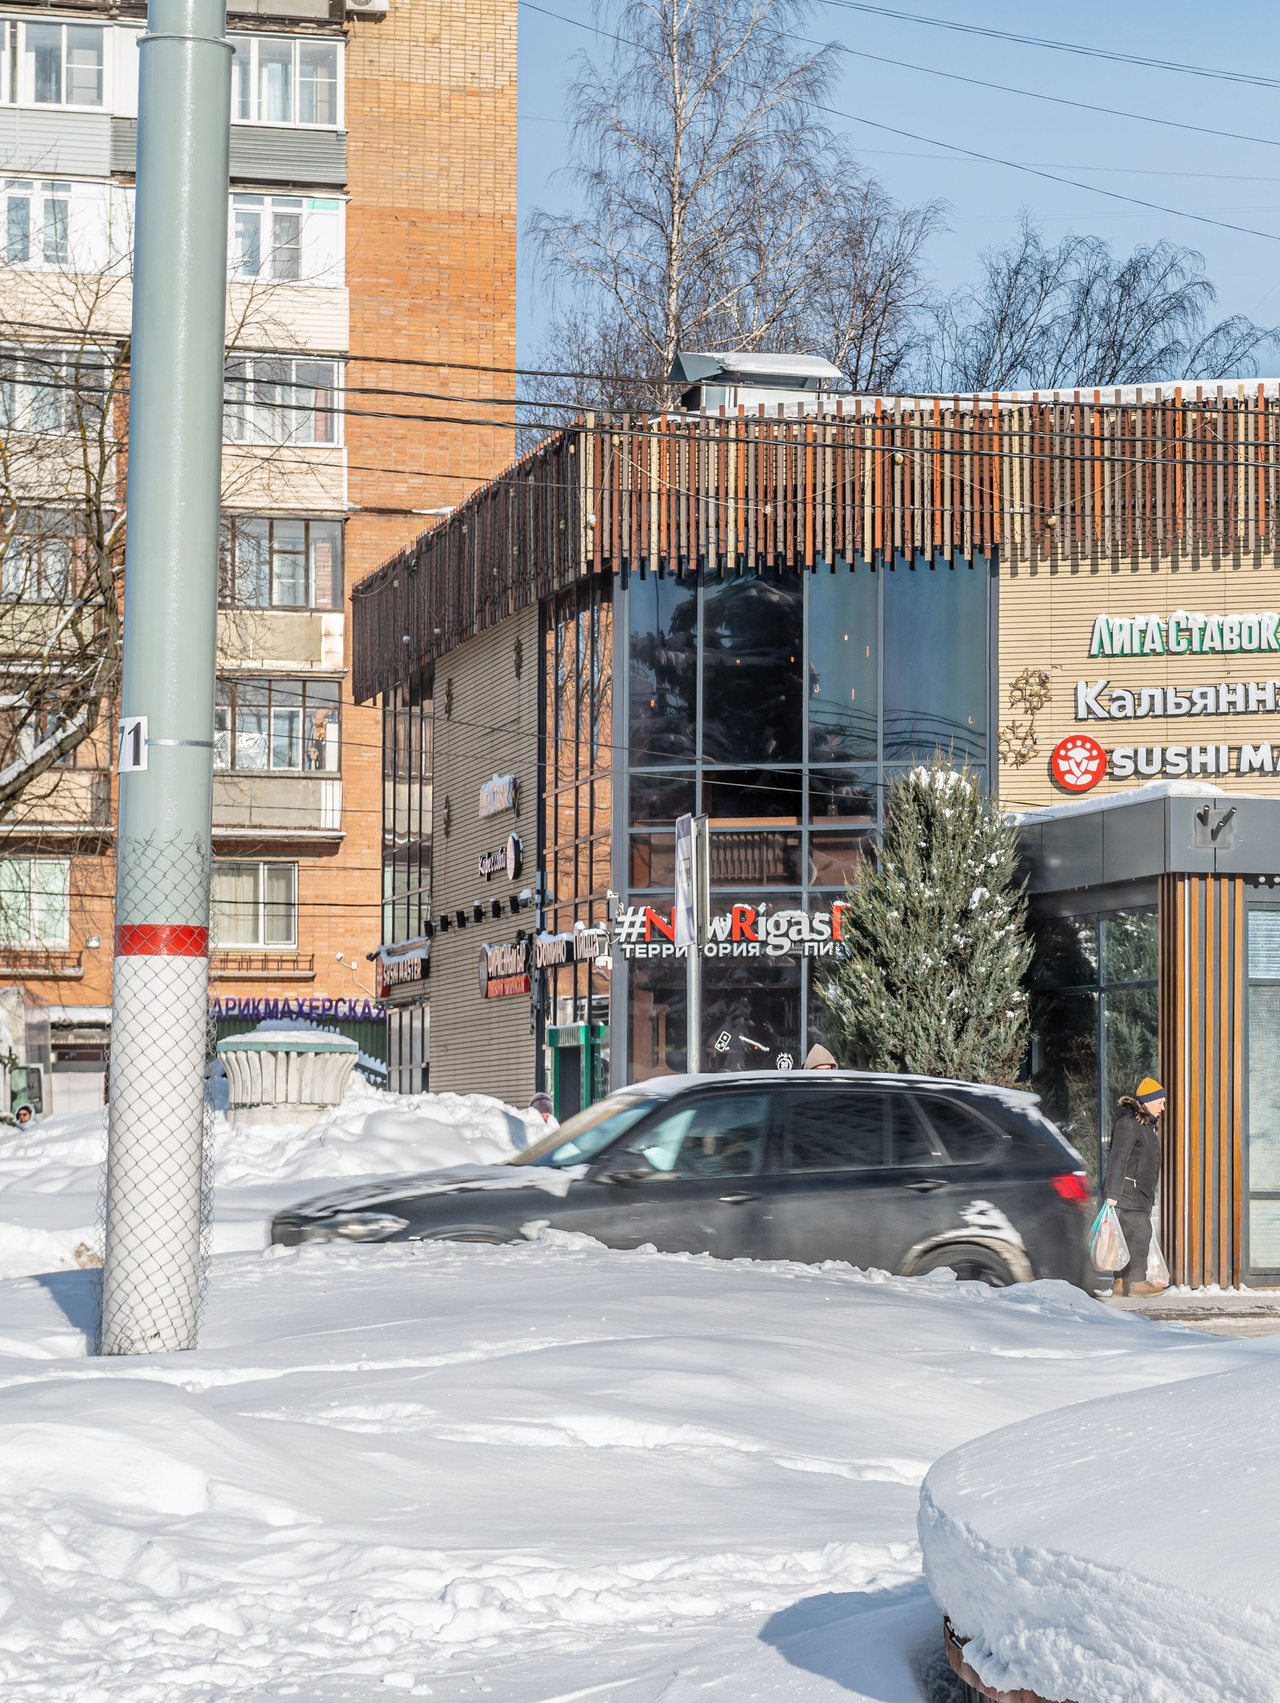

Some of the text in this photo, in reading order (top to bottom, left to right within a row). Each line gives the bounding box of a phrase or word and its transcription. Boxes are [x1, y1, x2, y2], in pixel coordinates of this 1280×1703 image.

[1111, 744, 1230, 777] SUSHI
[622, 943, 762, 959] ТЕРРИОРИЯ
[399, 957, 422, 984] MASTER
[209, 997, 387, 1021] АРИКМАХЕРСКАЯ
